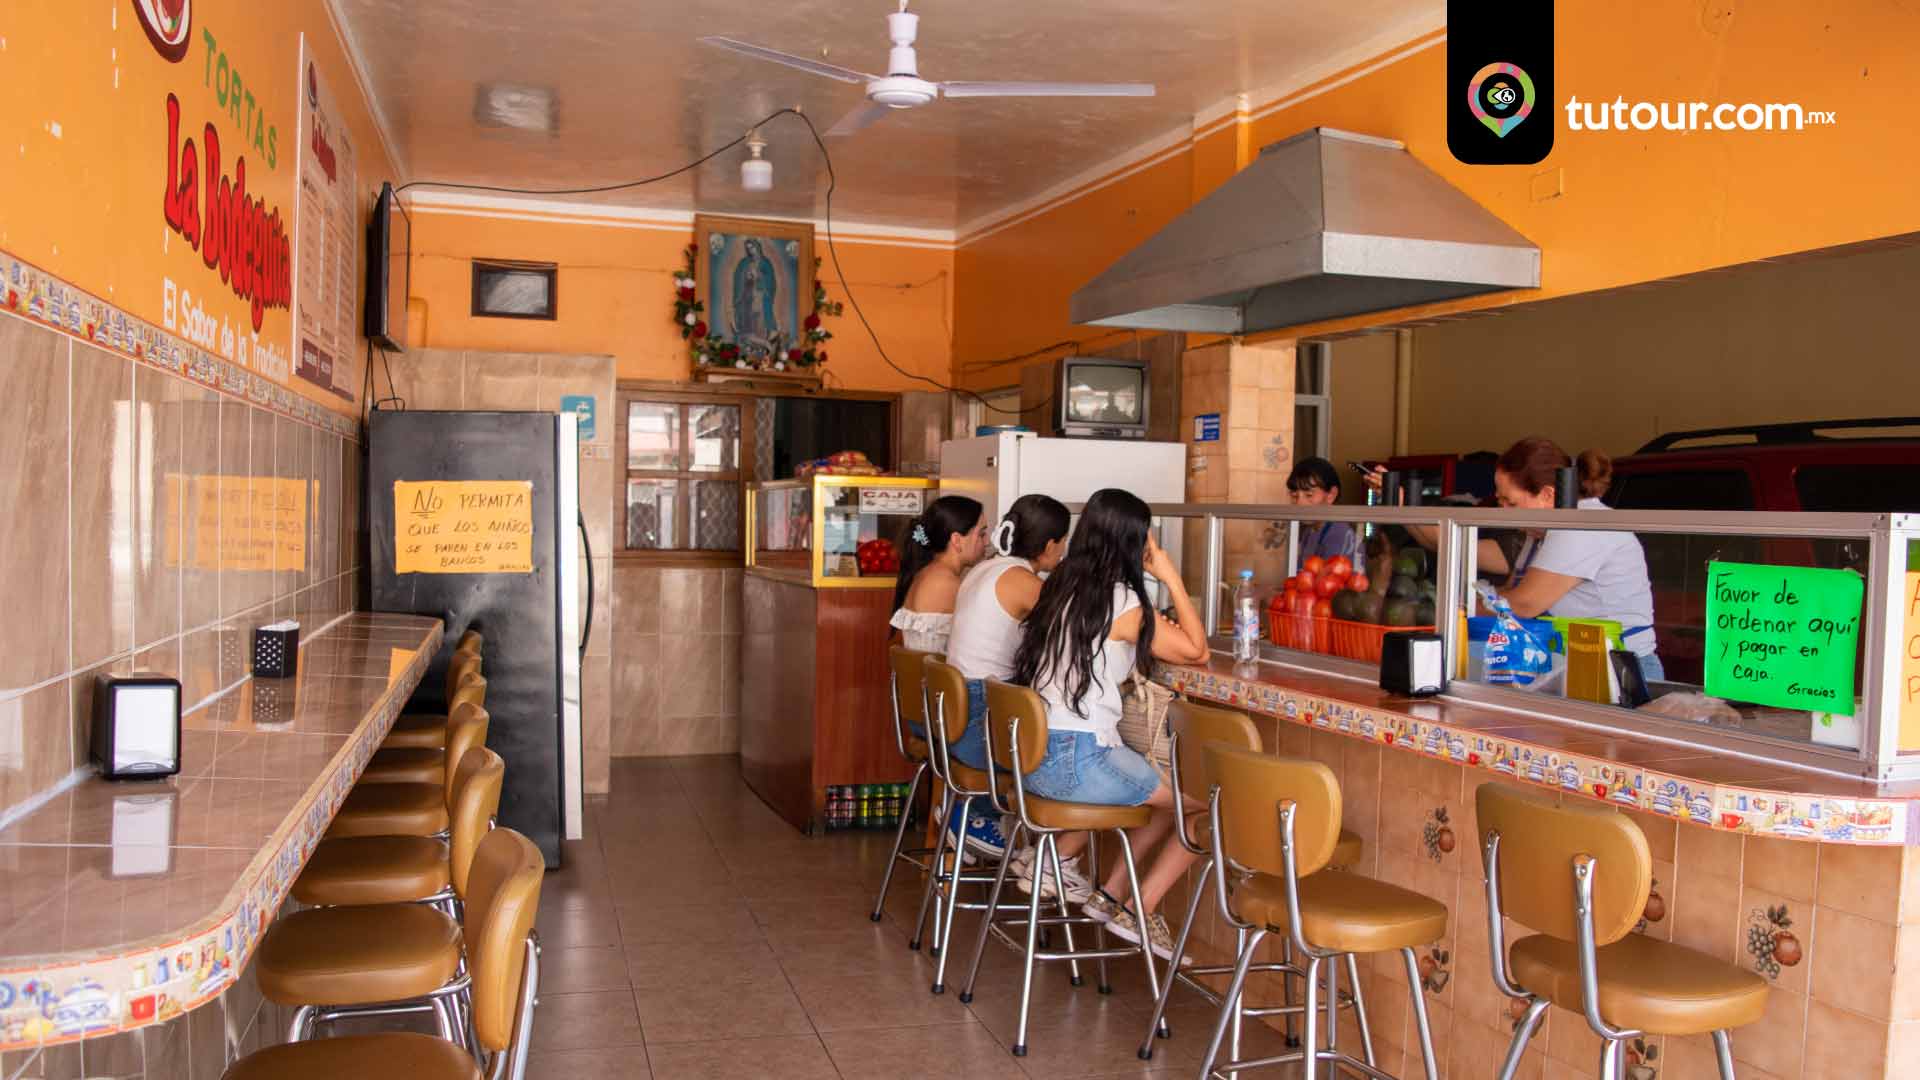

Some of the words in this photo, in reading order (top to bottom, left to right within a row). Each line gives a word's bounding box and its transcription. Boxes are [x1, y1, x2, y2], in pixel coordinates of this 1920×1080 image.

[203, 26, 277, 171] TORTAS
[164, 92, 200, 251] La
[163, 276, 177, 331] El
[181, 290, 217, 350] Sabor
[221, 313, 234, 360] de
[238, 322, 247, 366] la
[459, 493, 524, 511] PERMITA
[863, 491, 917, 499] CAJA
[408, 523, 440, 537] QUE
[454, 520, 479, 533] LOS
[488, 518, 531, 534] NIÑOS
[406, 544, 423, 553] SE
[475, 542, 491, 552] EN
[498, 542, 518, 551] LOS
[1715, 572, 1760, 603] Favor
[1774, 579, 1799, 605] de
[1718, 609, 1796, 633] ordenar
[1808, 616, 1857, 646] aquí
[1720, 640, 1729, 660] y
[1738, 639, 1787, 661] pagar
[1800, 645, 1818, 657] en
[1787, 683, 1836, 699] Gracias
